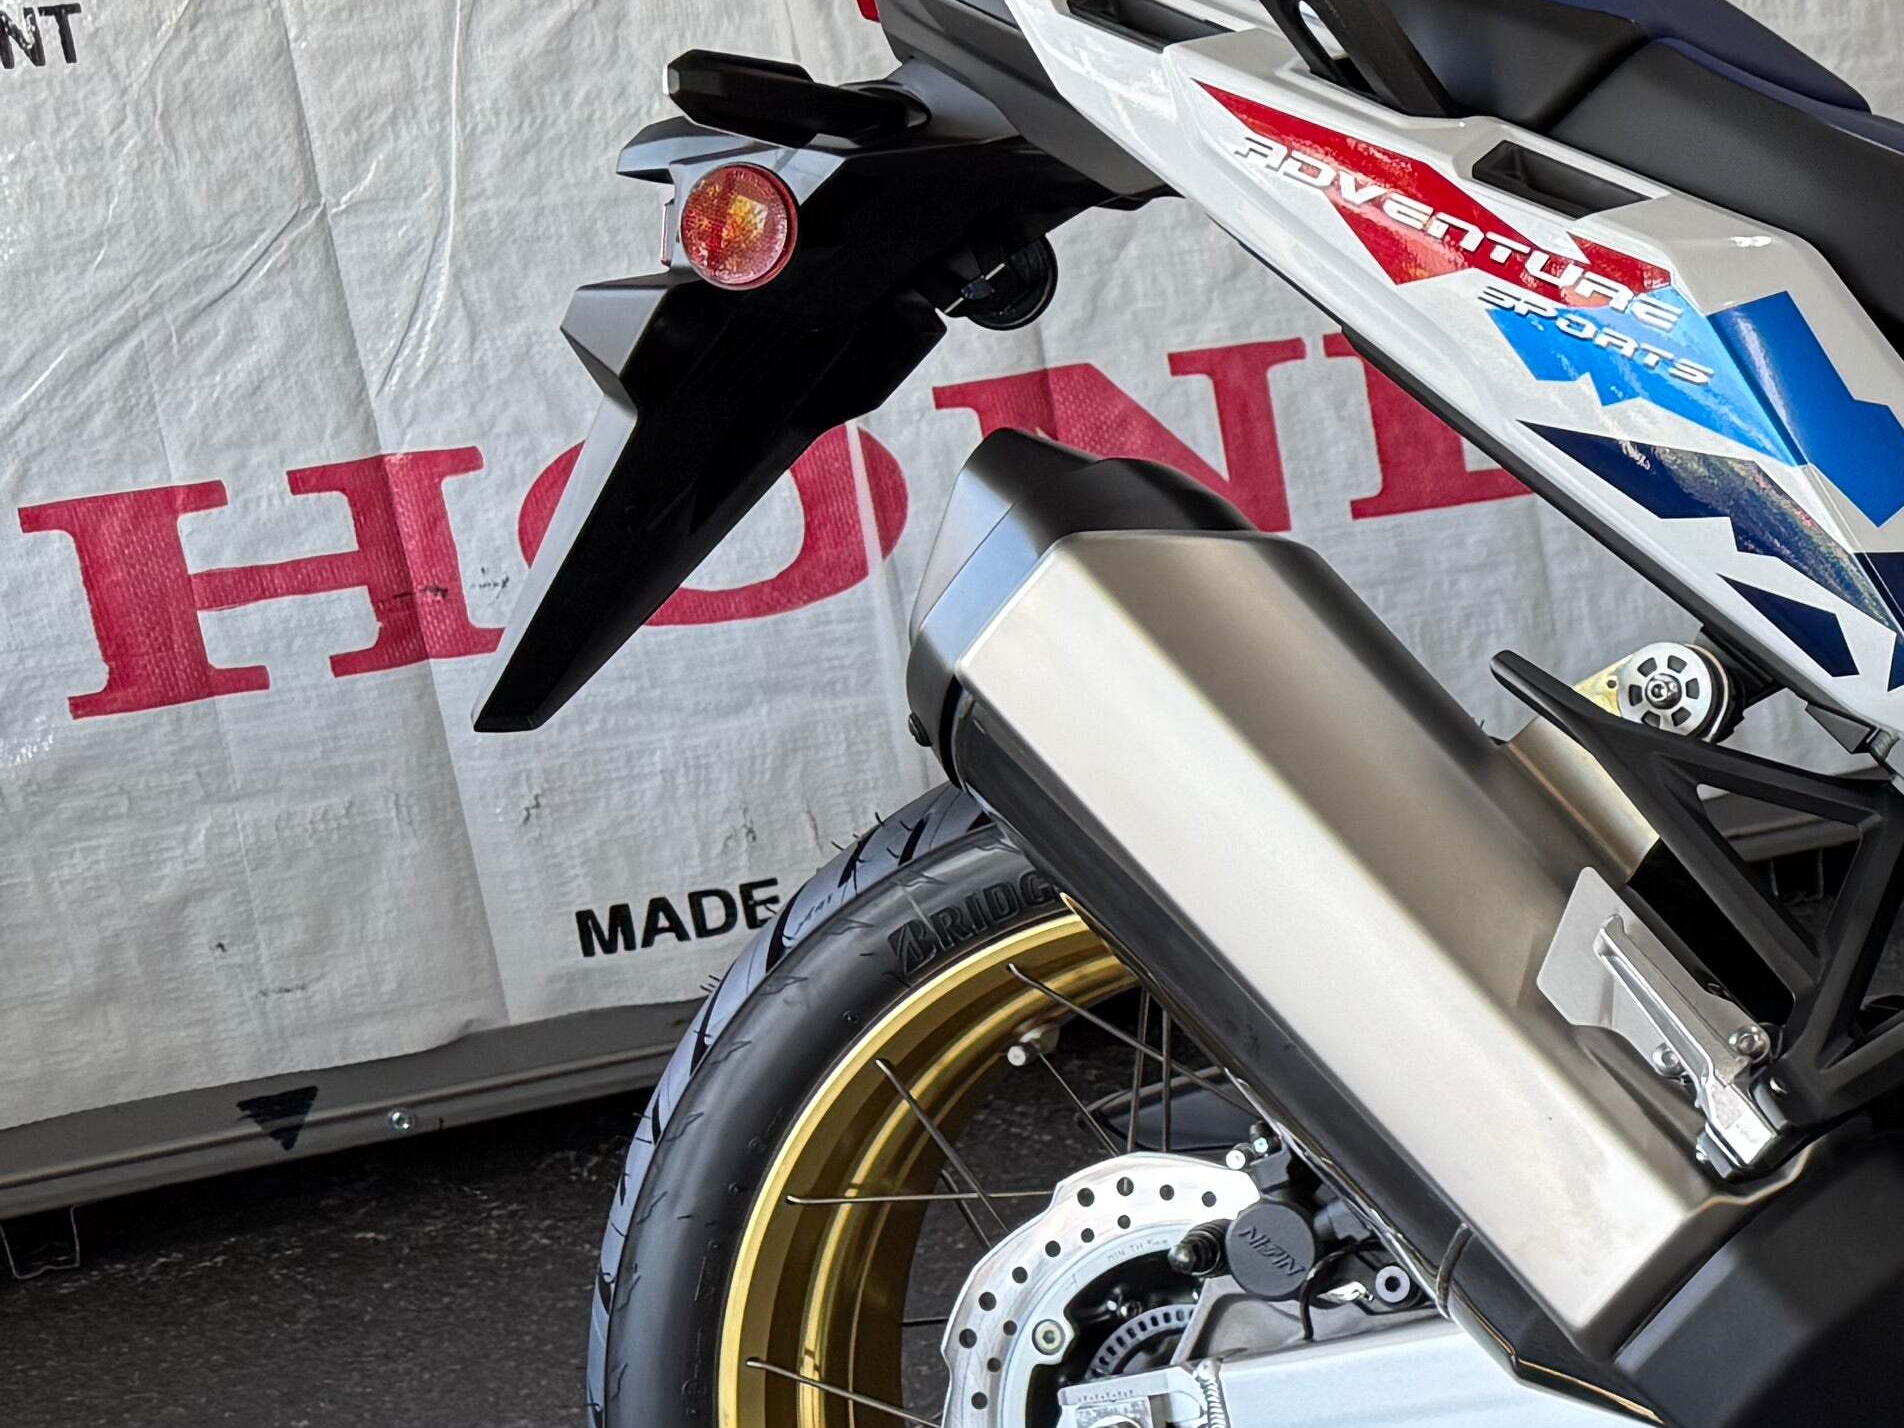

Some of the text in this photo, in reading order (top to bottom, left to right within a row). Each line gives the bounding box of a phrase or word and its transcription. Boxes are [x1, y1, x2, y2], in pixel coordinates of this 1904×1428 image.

[1234, 136, 1685, 333] ADVENTURE
[1479, 285, 1716, 387] SPORTS
[575, 877, 782, 959] MADE
